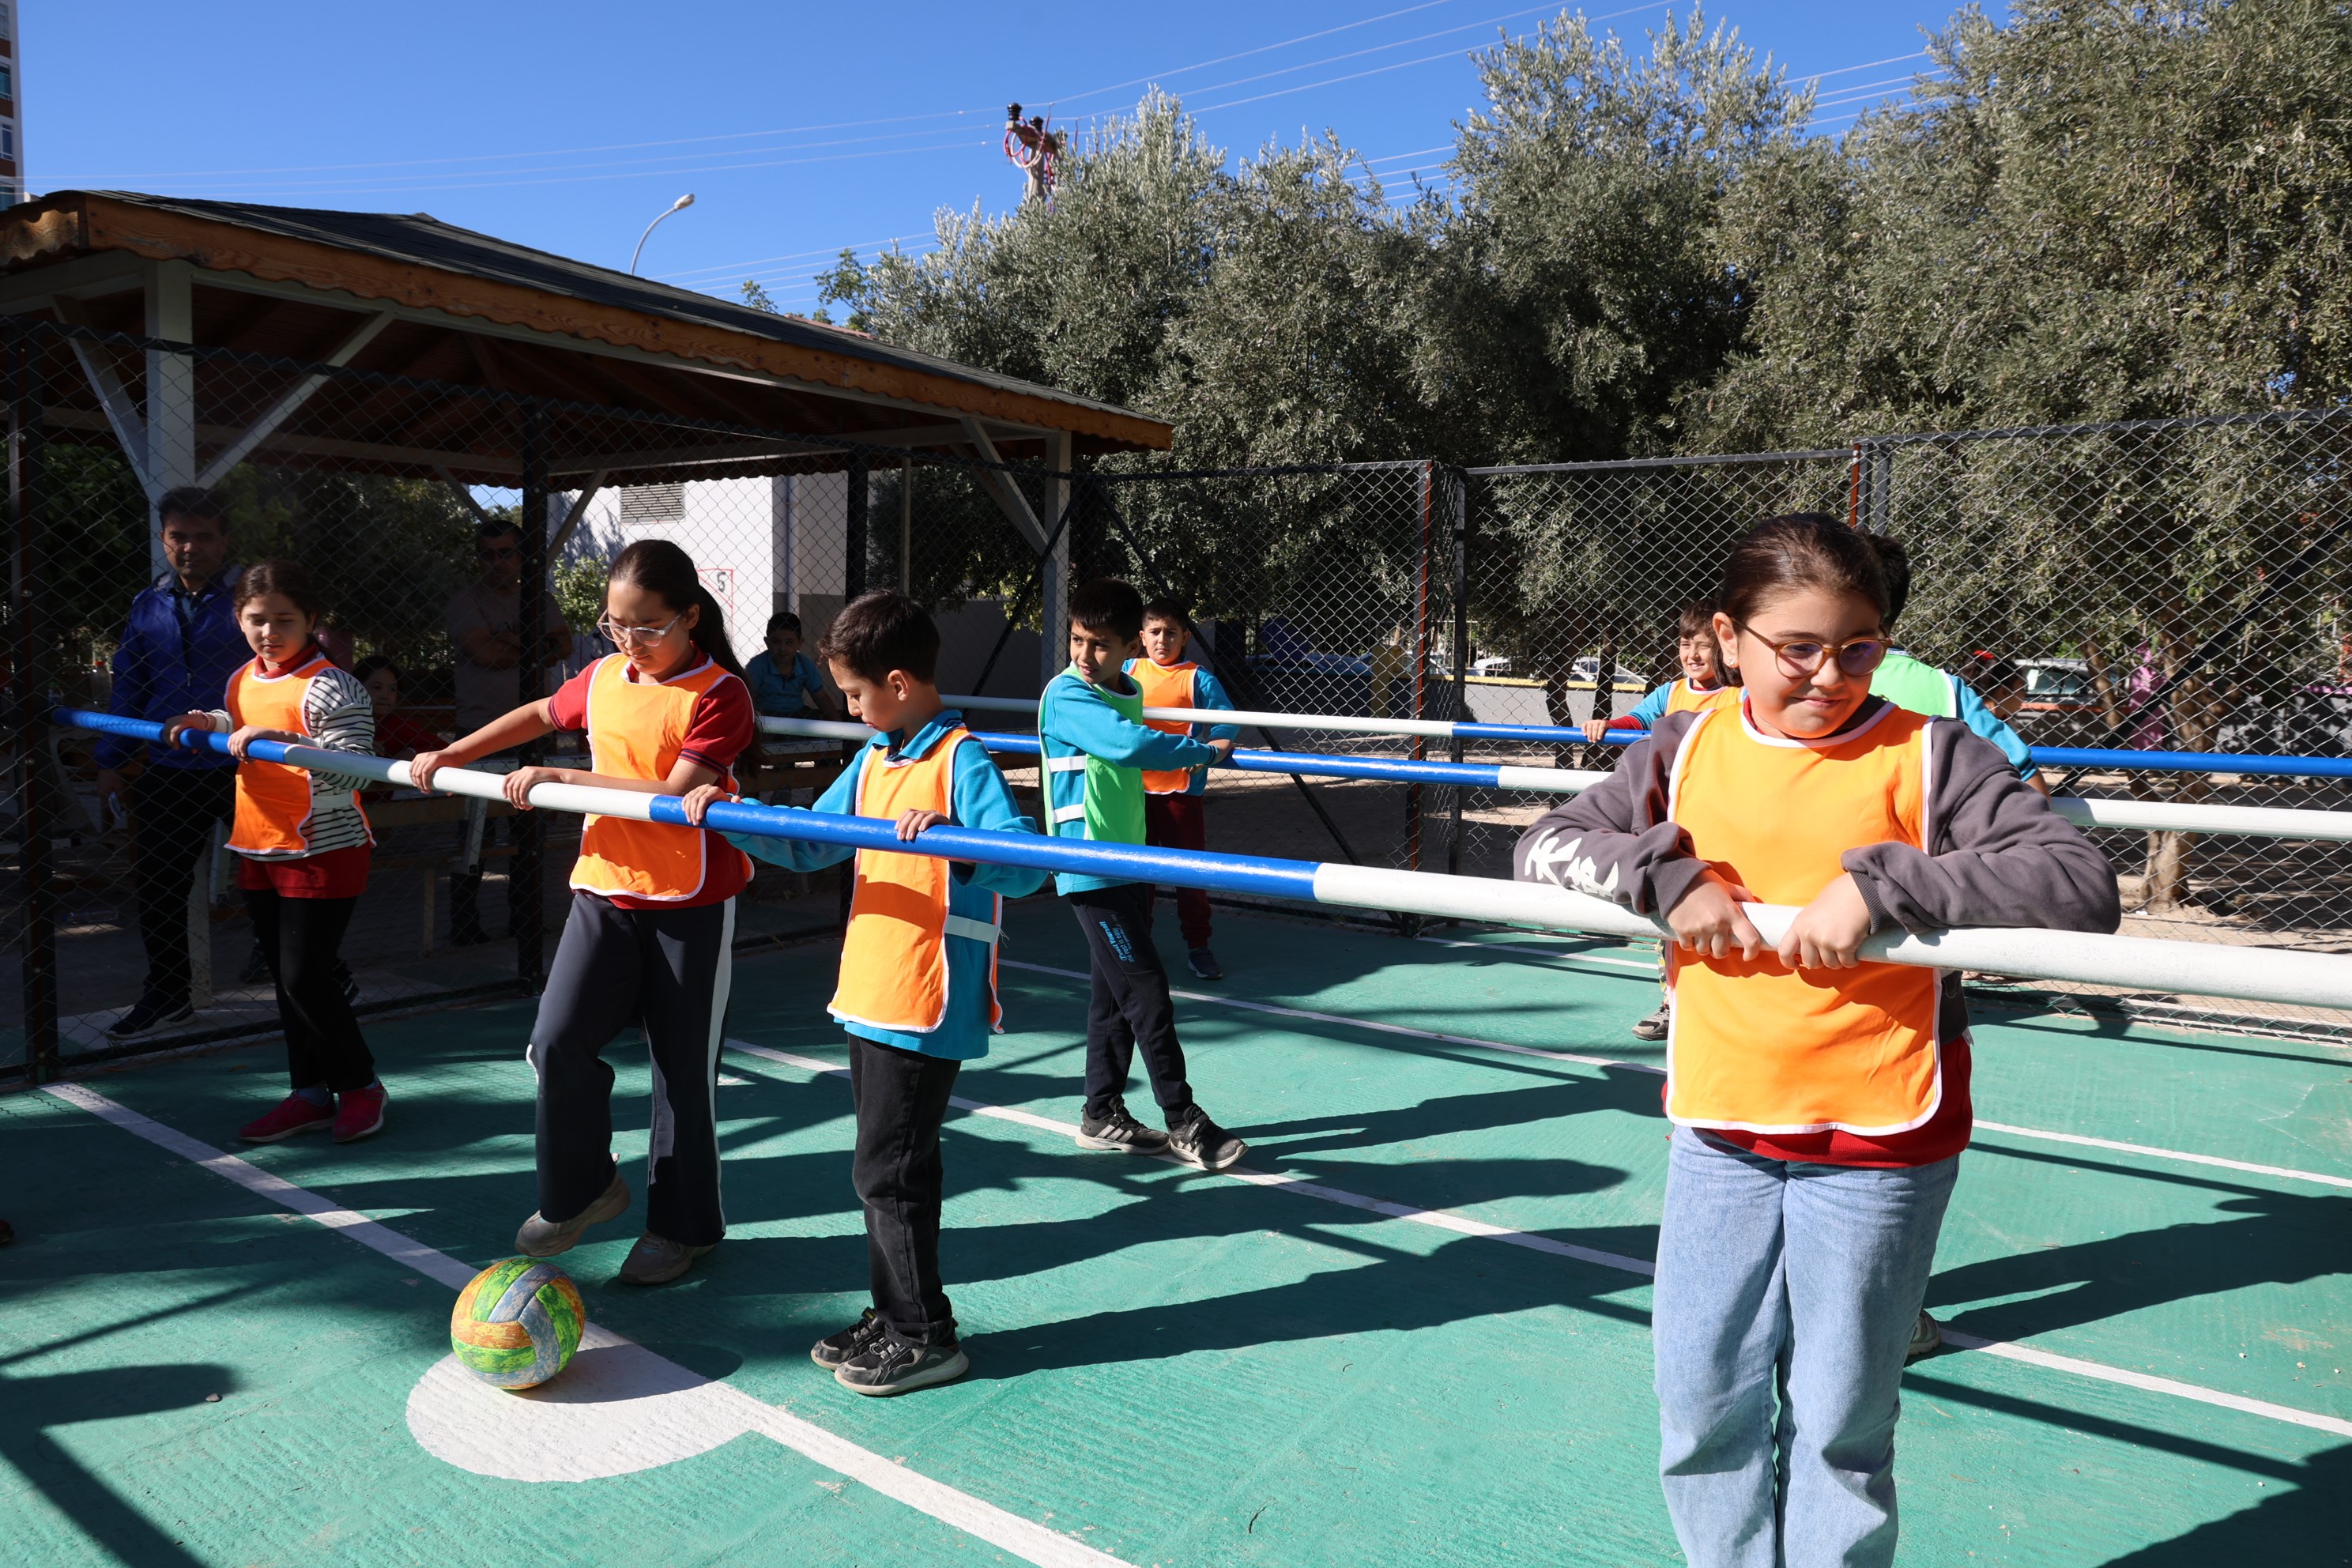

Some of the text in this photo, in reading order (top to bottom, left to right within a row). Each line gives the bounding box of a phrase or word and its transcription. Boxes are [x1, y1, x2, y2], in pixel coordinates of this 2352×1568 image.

[717, 571, 726, 592] 5
[1099, 921, 1116, 944] Yourself
[1112, 927, 1121, 939] easy
[1120, 944, 1130, 955] rest
[1188, 1123, 1199, 1136] adidas
